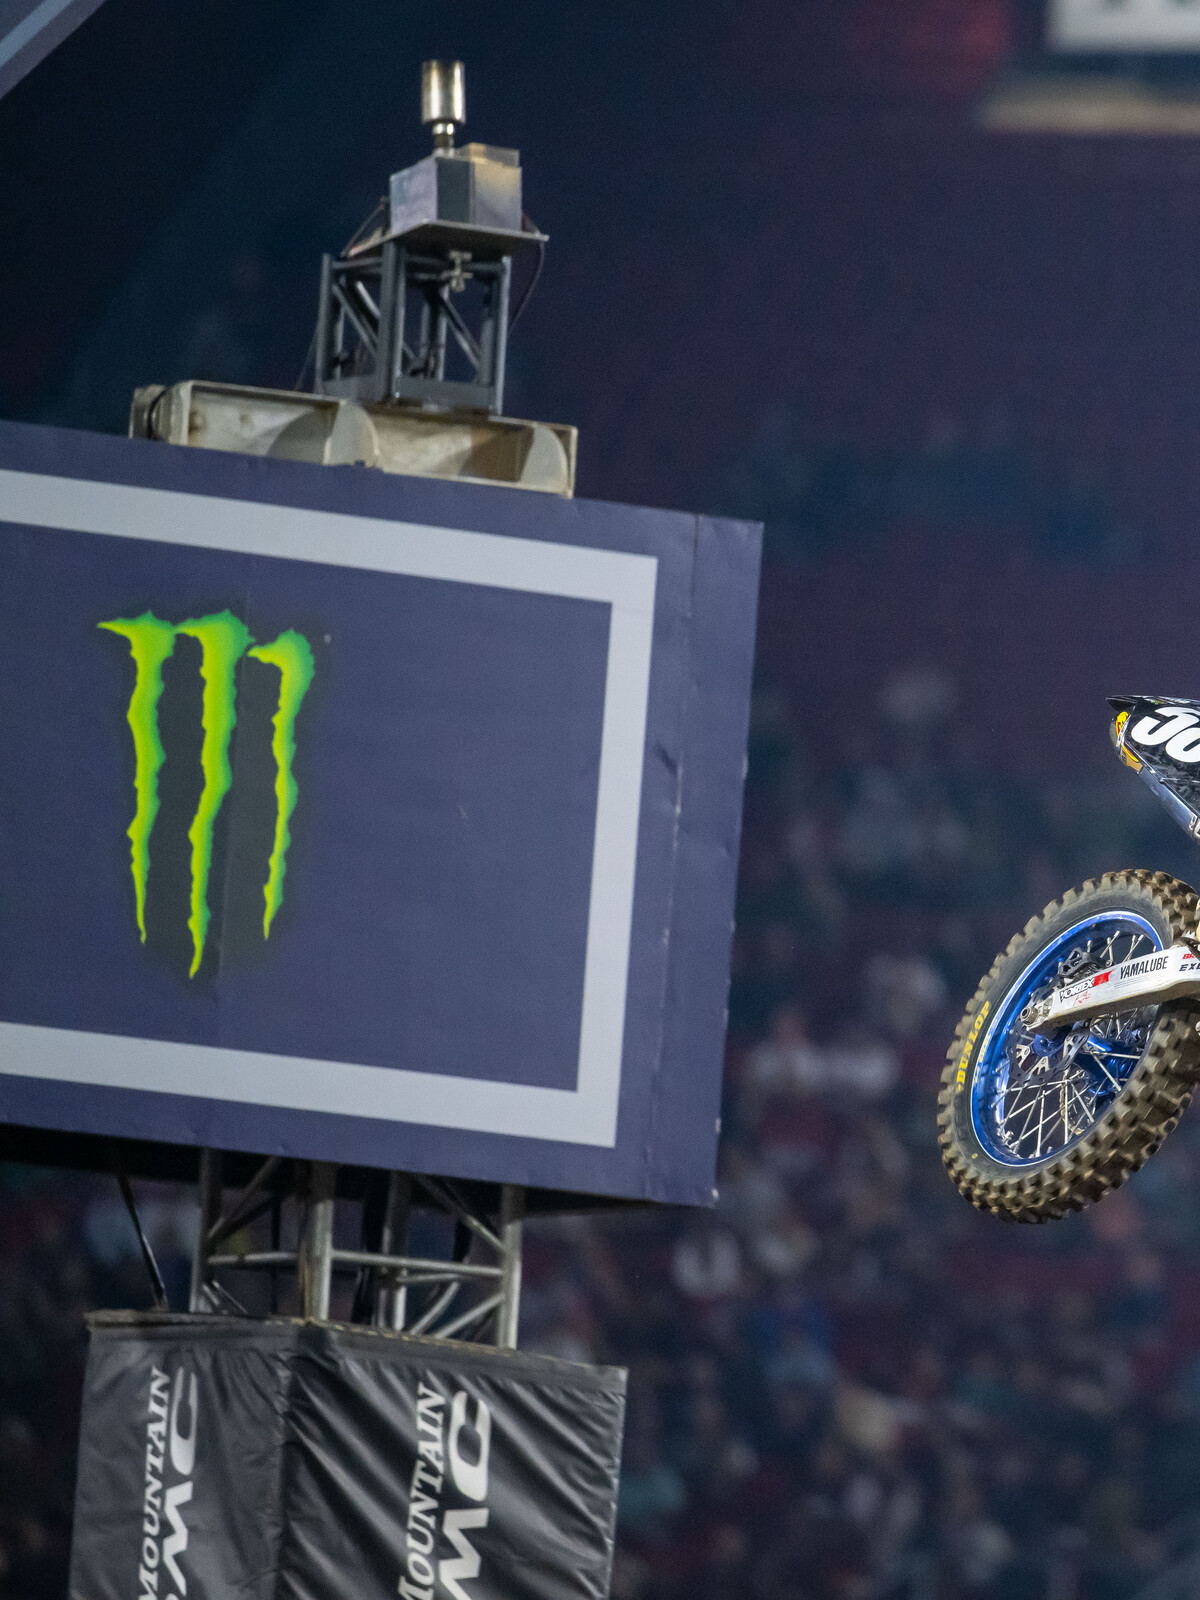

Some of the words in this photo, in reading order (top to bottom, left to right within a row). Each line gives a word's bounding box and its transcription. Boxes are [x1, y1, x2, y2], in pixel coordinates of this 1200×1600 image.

[1119, 956, 1170, 980] YAMALUBE
[956, 1001, 991, 1084] DUNLOP
[137, 1365, 171, 1600] MOUNTAIN
